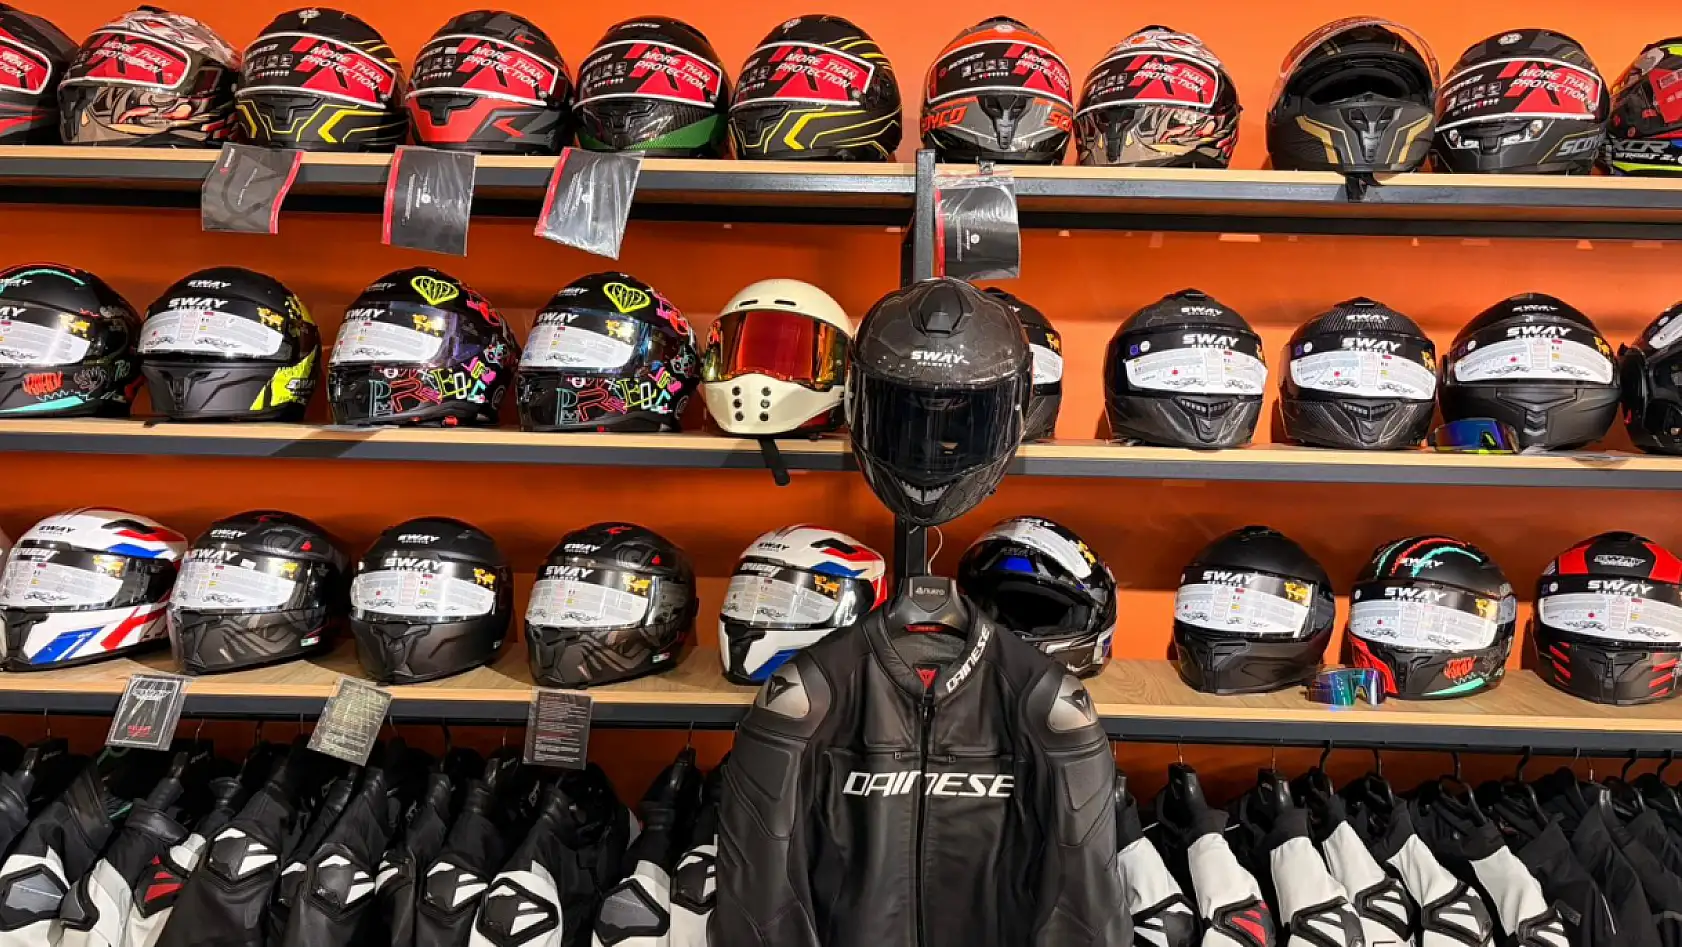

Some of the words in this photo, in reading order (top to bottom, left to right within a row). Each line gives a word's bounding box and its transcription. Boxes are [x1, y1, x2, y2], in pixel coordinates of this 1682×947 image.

[300, 54, 378, 90] PROTECTION
[311, 46, 352, 62] MORE
[352, 61, 384, 84] THAN
[462, 54, 539, 88] PROTECTION
[472, 46, 512, 62] MORE
[512, 58, 545, 81] THAN
[634, 59, 707, 89] PROTECTION
[642, 50, 681, 65] MORE
[682, 60, 711, 82] THAN
[775, 62, 852, 88] PROTECTION
[785, 52, 823, 66] MORE
[824, 59, 858, 80] THAN
[1142, 61, 1179, 73] MORE
[1180, 67, 1207, 86] THAN
[1509, 78, 1589, 104] PROTECTION
[1519, 68, 1562, 81] MORE
[1564, 74, 1593, 94] THAN
[168, 296, 229, 309] SWAY
[1181, 307, 1222, 315] SWAY
[537, 312, 580, 324] SWAY
[1182, 333, 1240, 347] SWAY
[1505, 325, 1572, 338] SWAY
[910, 349, 965, 364] SWAY
[1341, 337, 1401, 352] SWAY
[384, 557, 443, 570] SWAY
[544, 565, 595, 578] SWAY
[1202, 570, 1251, 584] SWAY
[1588, 578, 1654, 596] SWAY
[1384, 587, 1447, 601] SWAY
[945, 623, 991, 694] DAINESE
[842, 769, 1015, 798] DAINESE
